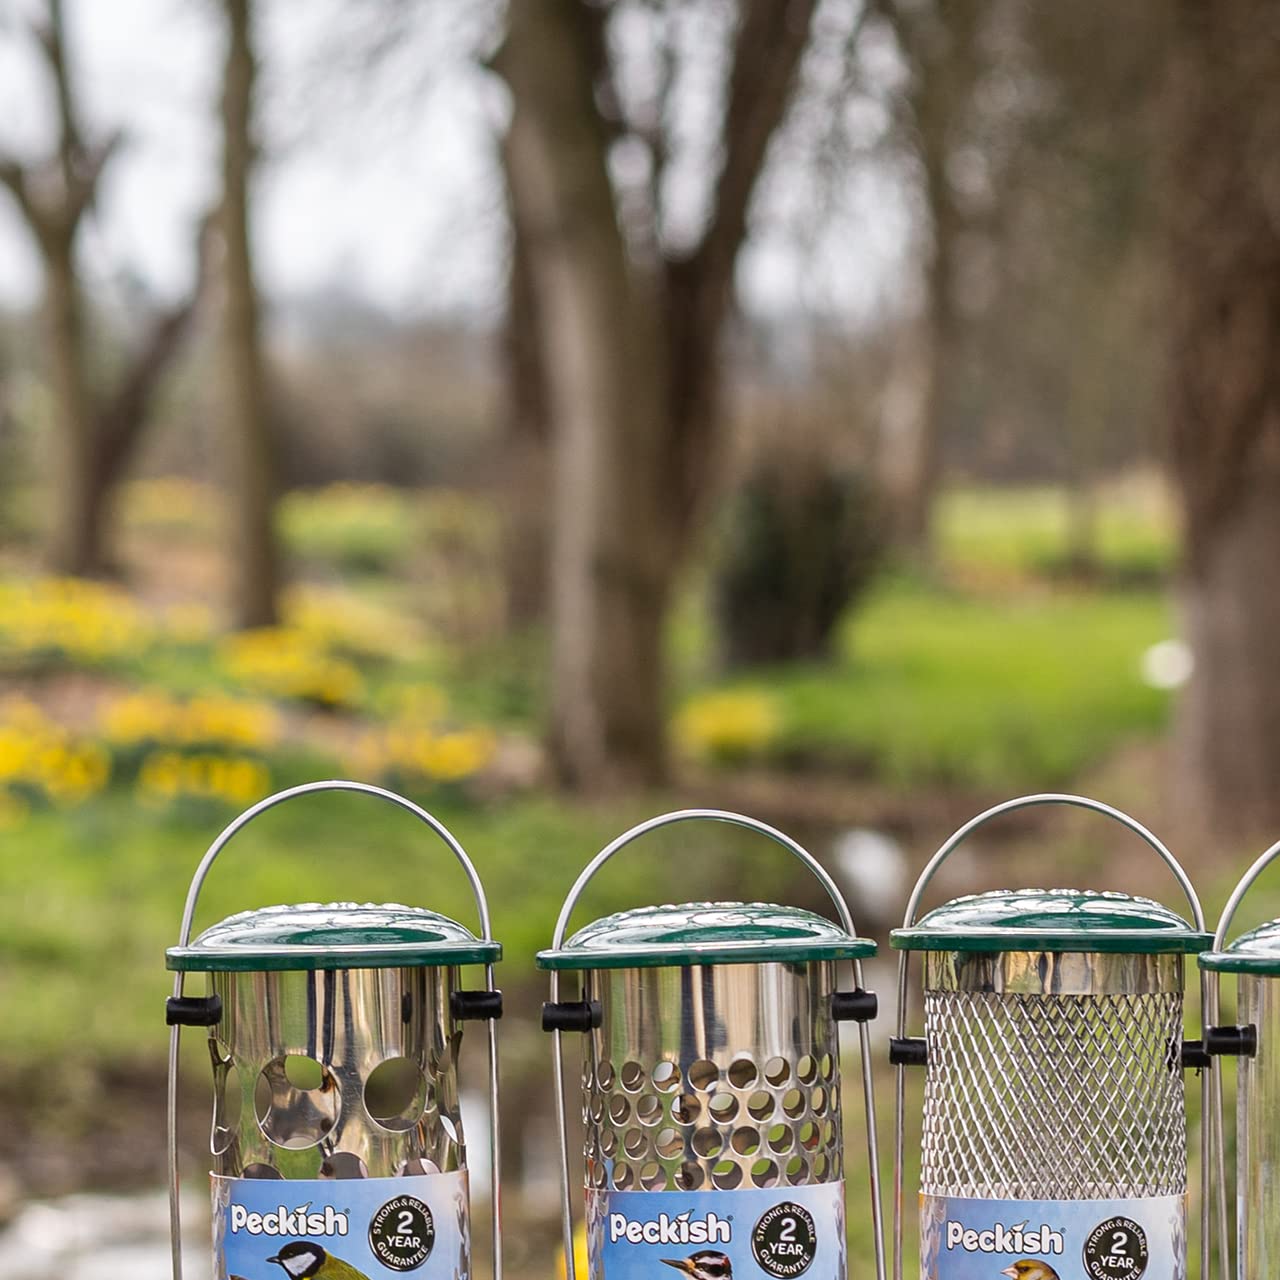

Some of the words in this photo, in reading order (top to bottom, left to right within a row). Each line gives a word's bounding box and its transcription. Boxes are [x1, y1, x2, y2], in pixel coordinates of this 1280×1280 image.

[230, 1202, 350, 1237] Peckish
[373, 1200, 400, 1235] STRONG
[397, 1211, 414, 1234] 2
[609, 1209, 732, 1245] Peckish
[756, 1206, 783, 1242] STRONG
[780, 1217, 796, 1241] 2
[386, 1235, 421, 1248] YEAR
[769, 1241, 803, 1255] YEAR
[946, 1220, 1064, 1255] Peckish
[1087, 1221, 1115, 1254] STRONG
[1111, 1231, 1128, 1254] 2
[377, 1241, 428, 1266] GUARANTEE
[760, 1249, 811, 1274] GUARANTEE
[1100, 1255, 1134, 1269] YEAR
